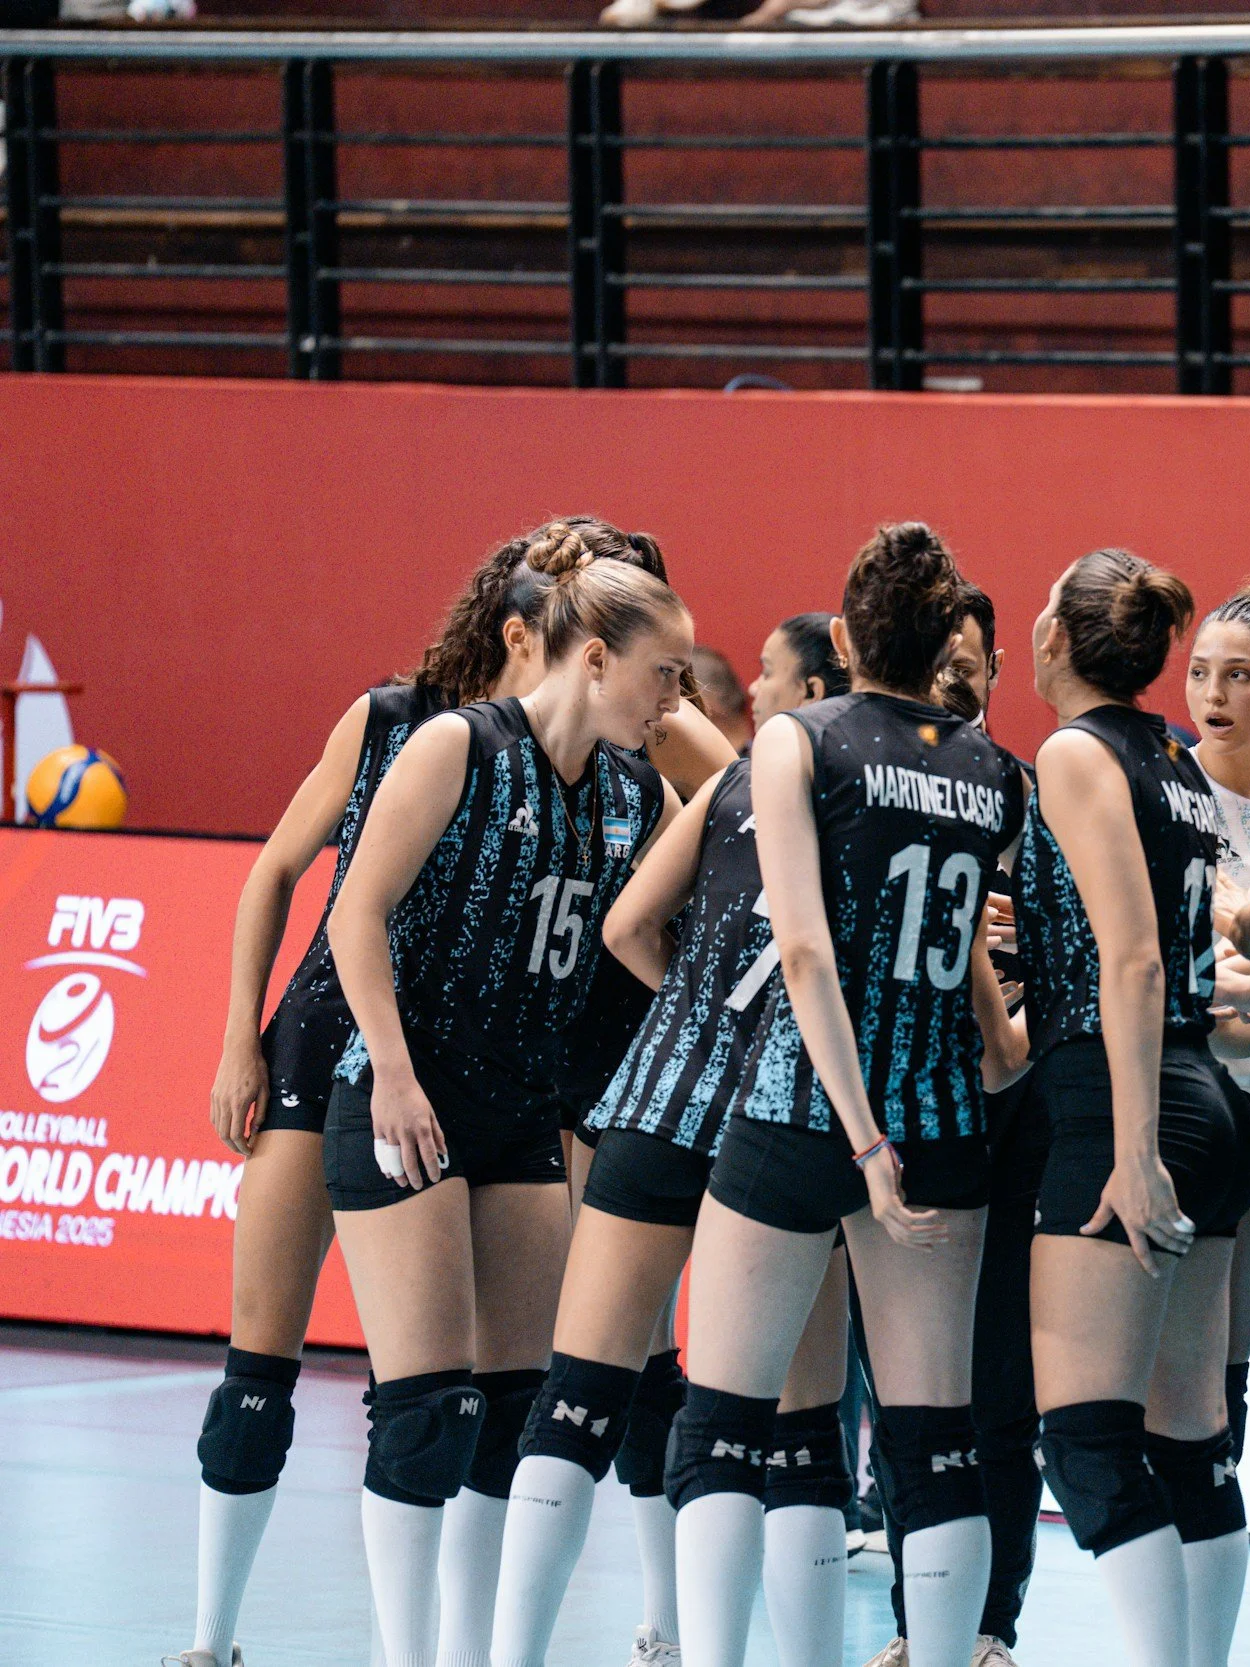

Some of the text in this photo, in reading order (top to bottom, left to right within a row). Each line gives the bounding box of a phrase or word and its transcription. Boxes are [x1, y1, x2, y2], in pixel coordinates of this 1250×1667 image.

[864, 763, 1004, 833] MARTINEZ CASAS
[604, 842, 631, 859] ARG
[47, 894, 145, 951] FIVB
[527, 874, 595, 980] 15
[887, 843, 982, 991] 13
[0, 1144, 95, 1208] ORLD
[55, 1213, 115, 1248] 2025
[240, 1394, 267, 1412] N1
[459, 1396, 480, 1416] N1
[551, 1399, 609, 1439] N1
